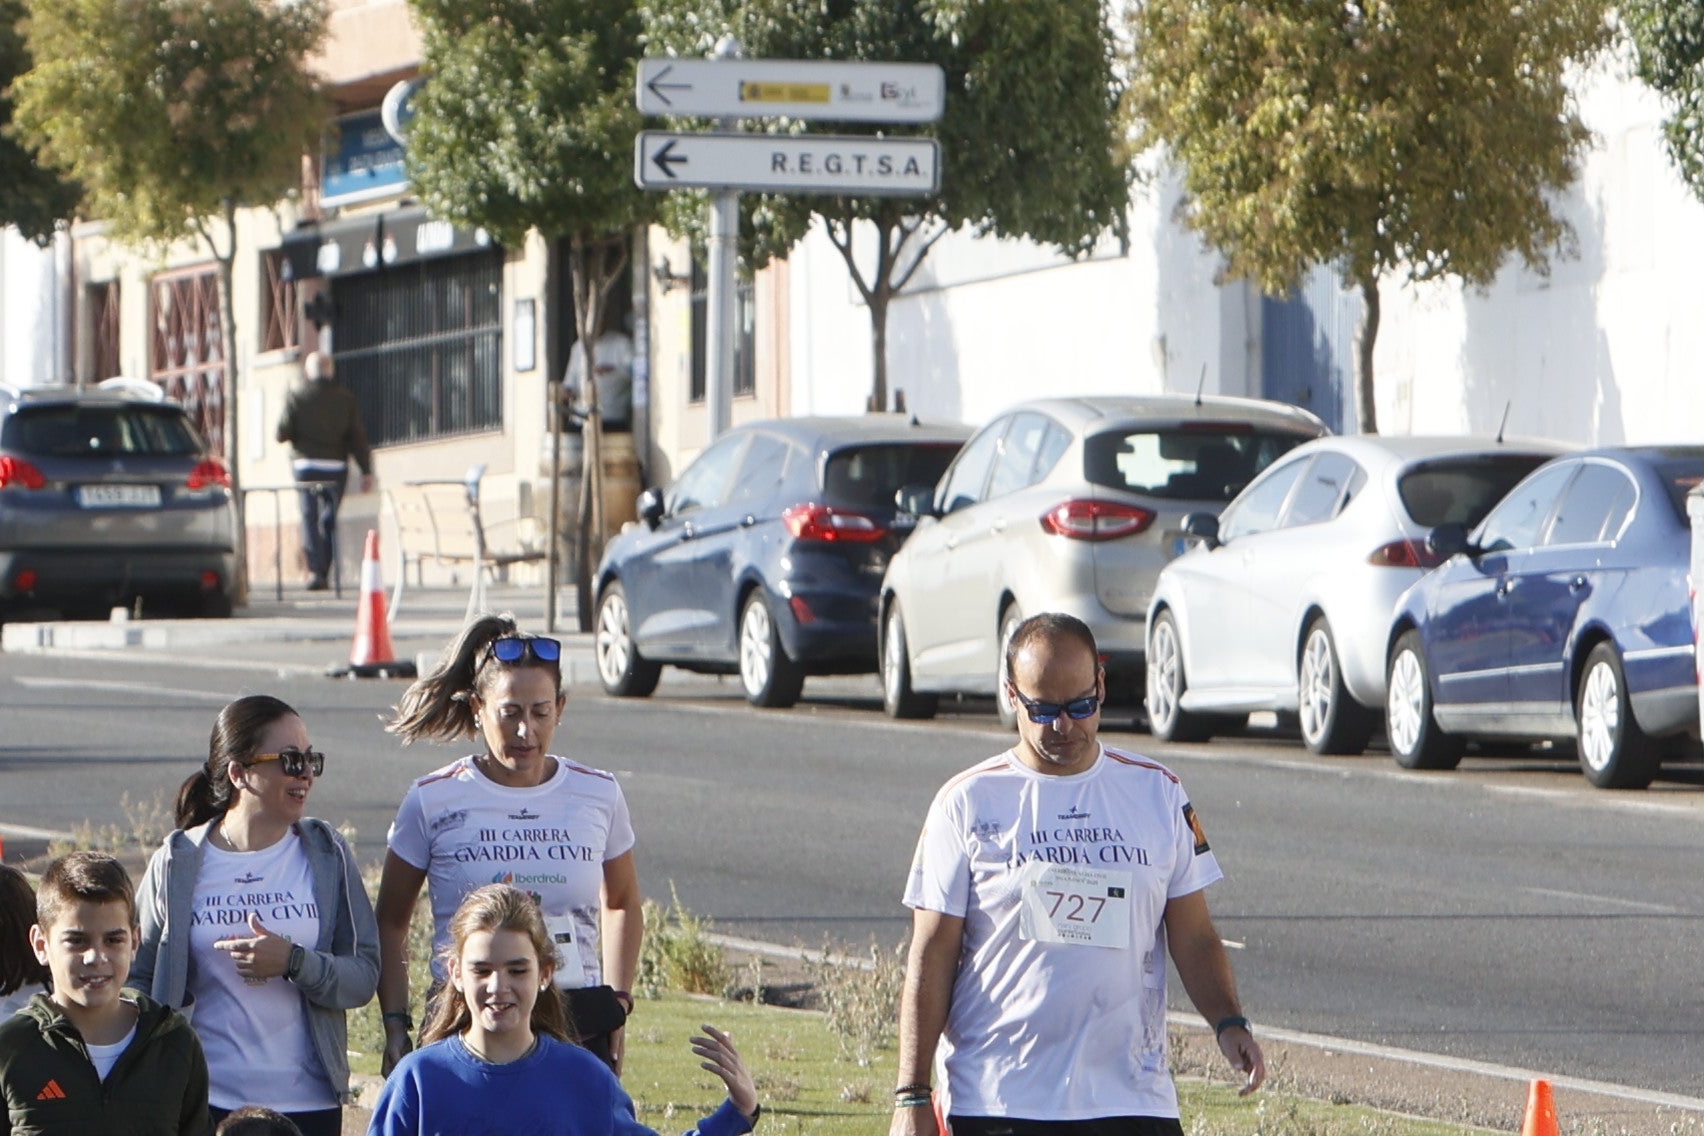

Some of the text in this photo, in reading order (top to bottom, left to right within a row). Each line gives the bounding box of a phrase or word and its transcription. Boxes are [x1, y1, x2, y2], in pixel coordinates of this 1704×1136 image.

[771, 151, 928, 176] R.E.G.T.S.A.
[480, 828, 571, 843] III CARRERA
[1030, 827, 1125, 845] III CARRERA
[454, 844, 594, 863] GVARDIA CIVIL
[1099, 845, 1153, 867] CIVIL
[206, 891, 294, 907] III CARRERA
[1046, 891, 1107, 923] 727
[191, 908, 264, 926] VARDIA
